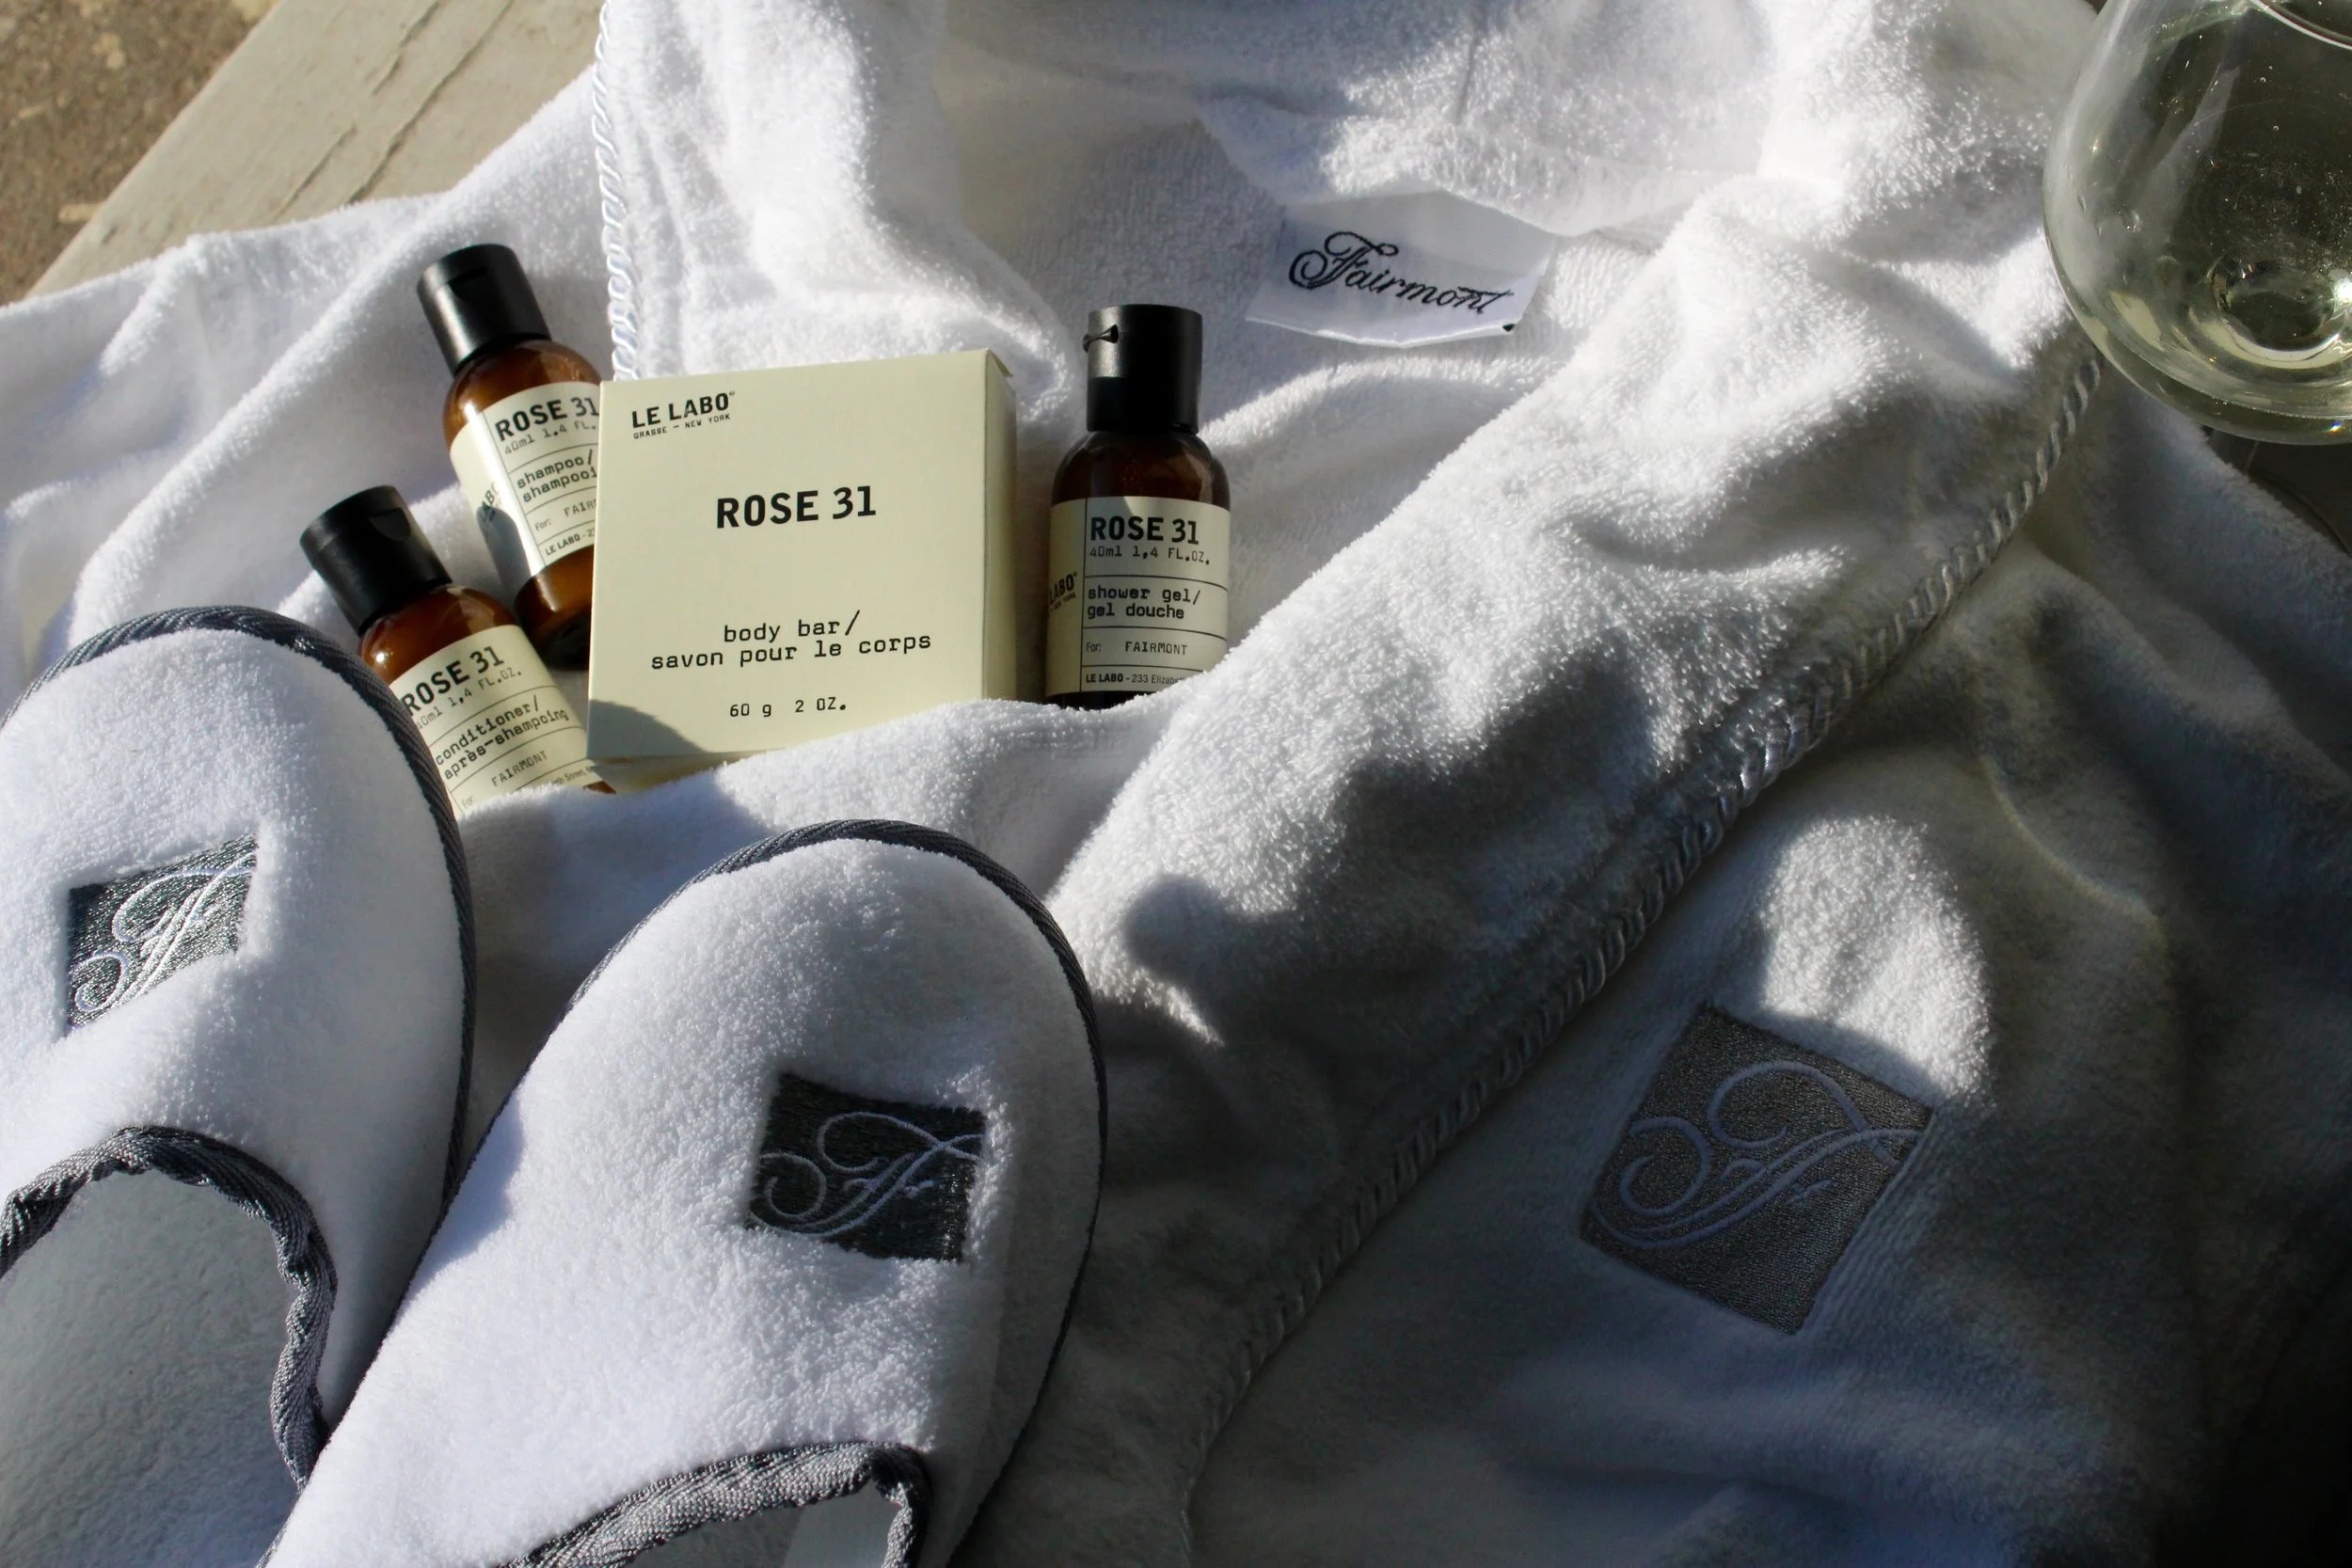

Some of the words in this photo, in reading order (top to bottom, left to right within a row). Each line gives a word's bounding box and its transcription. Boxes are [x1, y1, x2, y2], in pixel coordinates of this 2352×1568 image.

[1289, 231, 1514, 315] Fairmont
[495, 399, 568, 442] ROSE
[570, 397, 599, 417] 31
[574, 420, 596, 431] FL.
[632, 406, 661, 429] LE
[633, 426, 668, 439] GRASSE
[685, 420, 702, 429] NEW
[707, 413, 731, 423] YORK
[516, 449, 593, 489] shampoo/
[523, 466, 597, 502] shampooi
[564, 499, 596, 517] FAIR
[717, 490, 819, 529] ROSE
[832, 485, 877, 519] 31
[545, 546, 557, 556] LE
[557, 533, 580, 550] LABO
[1090, 515, 1164, 542] ROSE
[1171, 518, 1199, 546] 31
[1089, 546, 1122, 557] 40ml
[1168, 548, 1211, 565] FL.OZ.
[1088, 585, 1151, 599] shower
[1162, 588, 1200, 605] gel/
[723, 623, 781, 644] body
[798, 610, 860, 638] bar/
[1088, 603, 1115, 620] gel
[1125, 603, 1184, 619] douche
[651, 650, 723, 670] savon
[739, 645, 797, 667] pour
[814, 641, 842, 658] le
[858, 633, 931, 656] corps
[1086, 641, 1102, 653] For:
[1125, 641, 1188, 656] FAIRMONT
[402, 659, 469, 716] ROSE
[469, 645, 504, 673] 31
[1086, 673, 1096, 684] LE
[1099, 673, 1123, 683] LABO
[1132, 673, 1149, 684] 233
[729, 704, 750, 718] 60
[762, 704, 772, 718] g
[794, 699, 804, 713] 2
[816, 696, 847, 711] OZ.
[436, 694, 538, 766] conditioner/
[444, 709, 569, 780] après-shampoing
[491, 750, 548, 786] FAIRMONT
